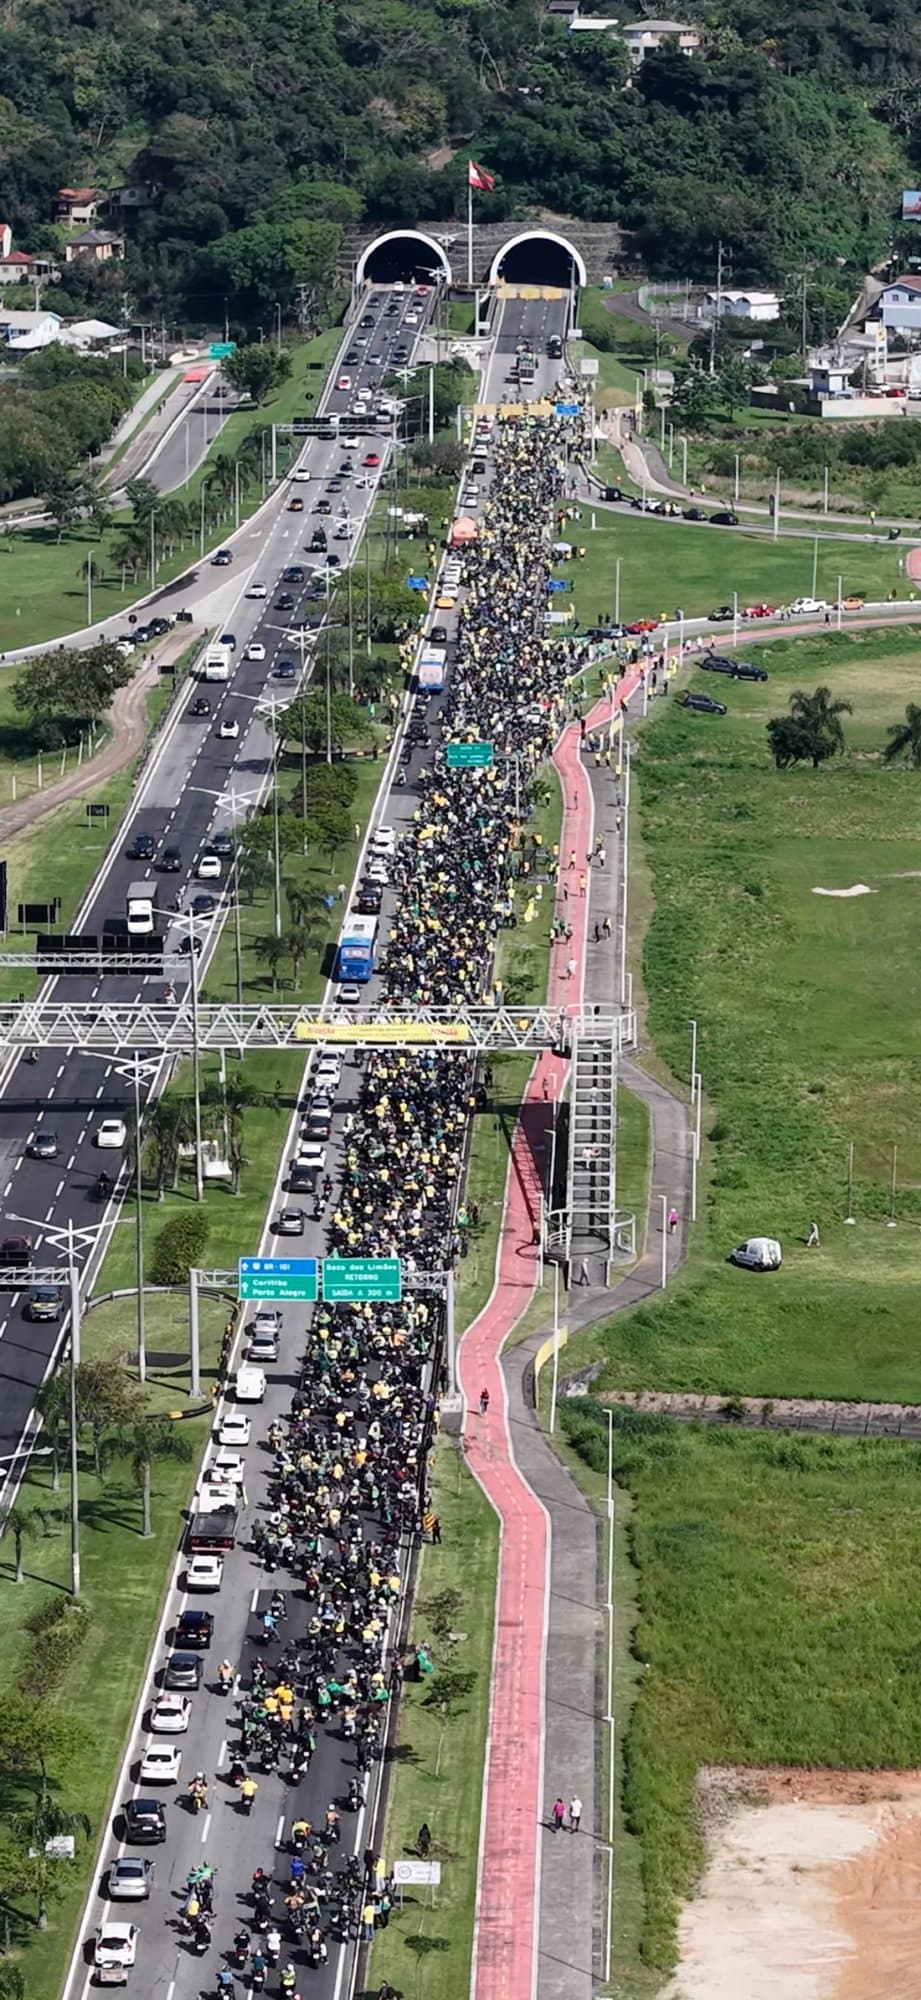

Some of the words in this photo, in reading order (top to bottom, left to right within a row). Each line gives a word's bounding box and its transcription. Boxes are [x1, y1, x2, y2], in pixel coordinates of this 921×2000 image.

[344, 1273, 379, 1281] RETORNO
[252, 1279, 287, 1287] Curitiba
[279, 1289, 306, 1298] Alegre
